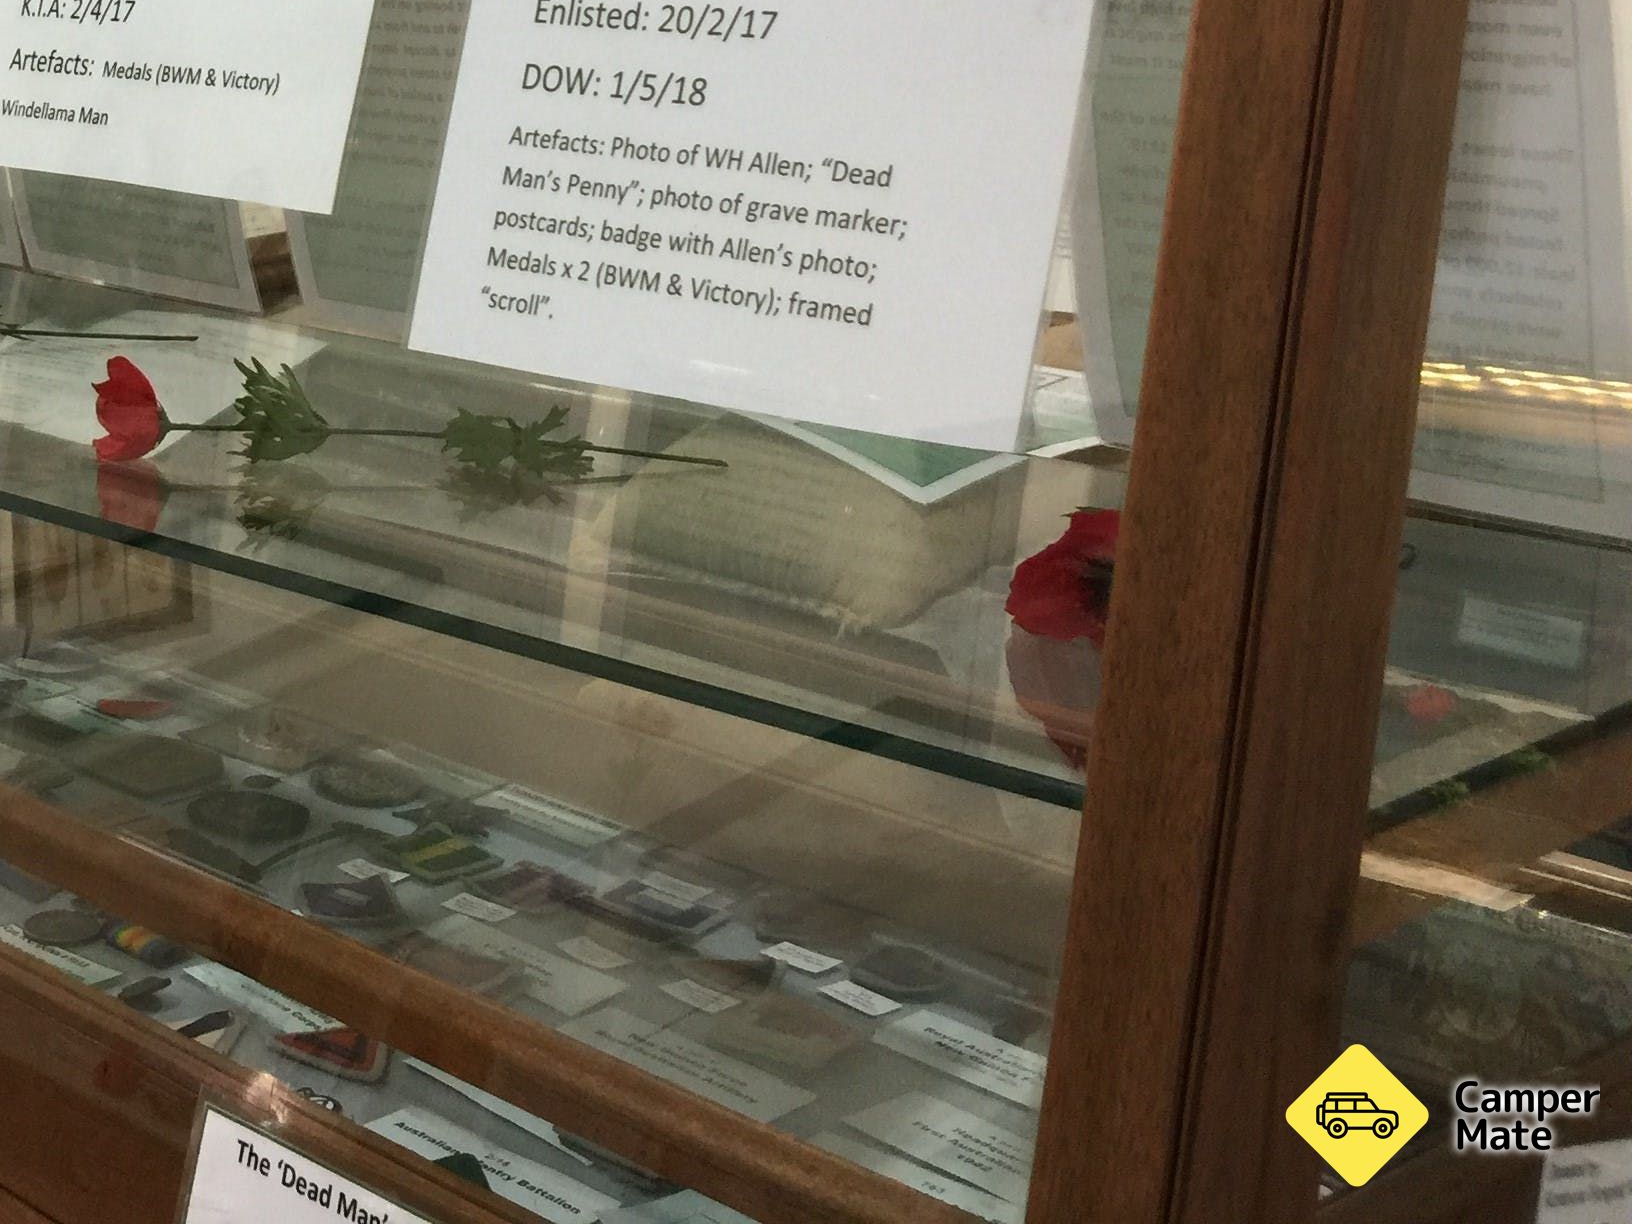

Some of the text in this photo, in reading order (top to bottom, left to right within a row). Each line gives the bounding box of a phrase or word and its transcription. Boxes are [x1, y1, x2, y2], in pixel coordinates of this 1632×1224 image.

[658, 5, 777, 40] 20/2/17
[9, 48, 279, 96] Artefacts: Medals (BWM & Victory)
[523, 64, 707, 107] DOW: 1/5/18
[1, 100, 108, 126] Windellama Man
[509, 126, 893, 188] Artefacts: Photo of WH Allen; “Dead
[502, 166, 908, 240] Man’s Penny”; photo of grave marker;
[493, 207, 877, 284] postcards; badge with Allen’s photo;
[481, 285, 553, 319] “scroll”.
[487, 246, 873, 327] Medals x 2 (BWM & Victory); framed
[238, 1139, 270, 1176] The
[278, 1160, 332, 1208] ‘Dead
[394, 1121, 581, 1215] Australian Battalion
